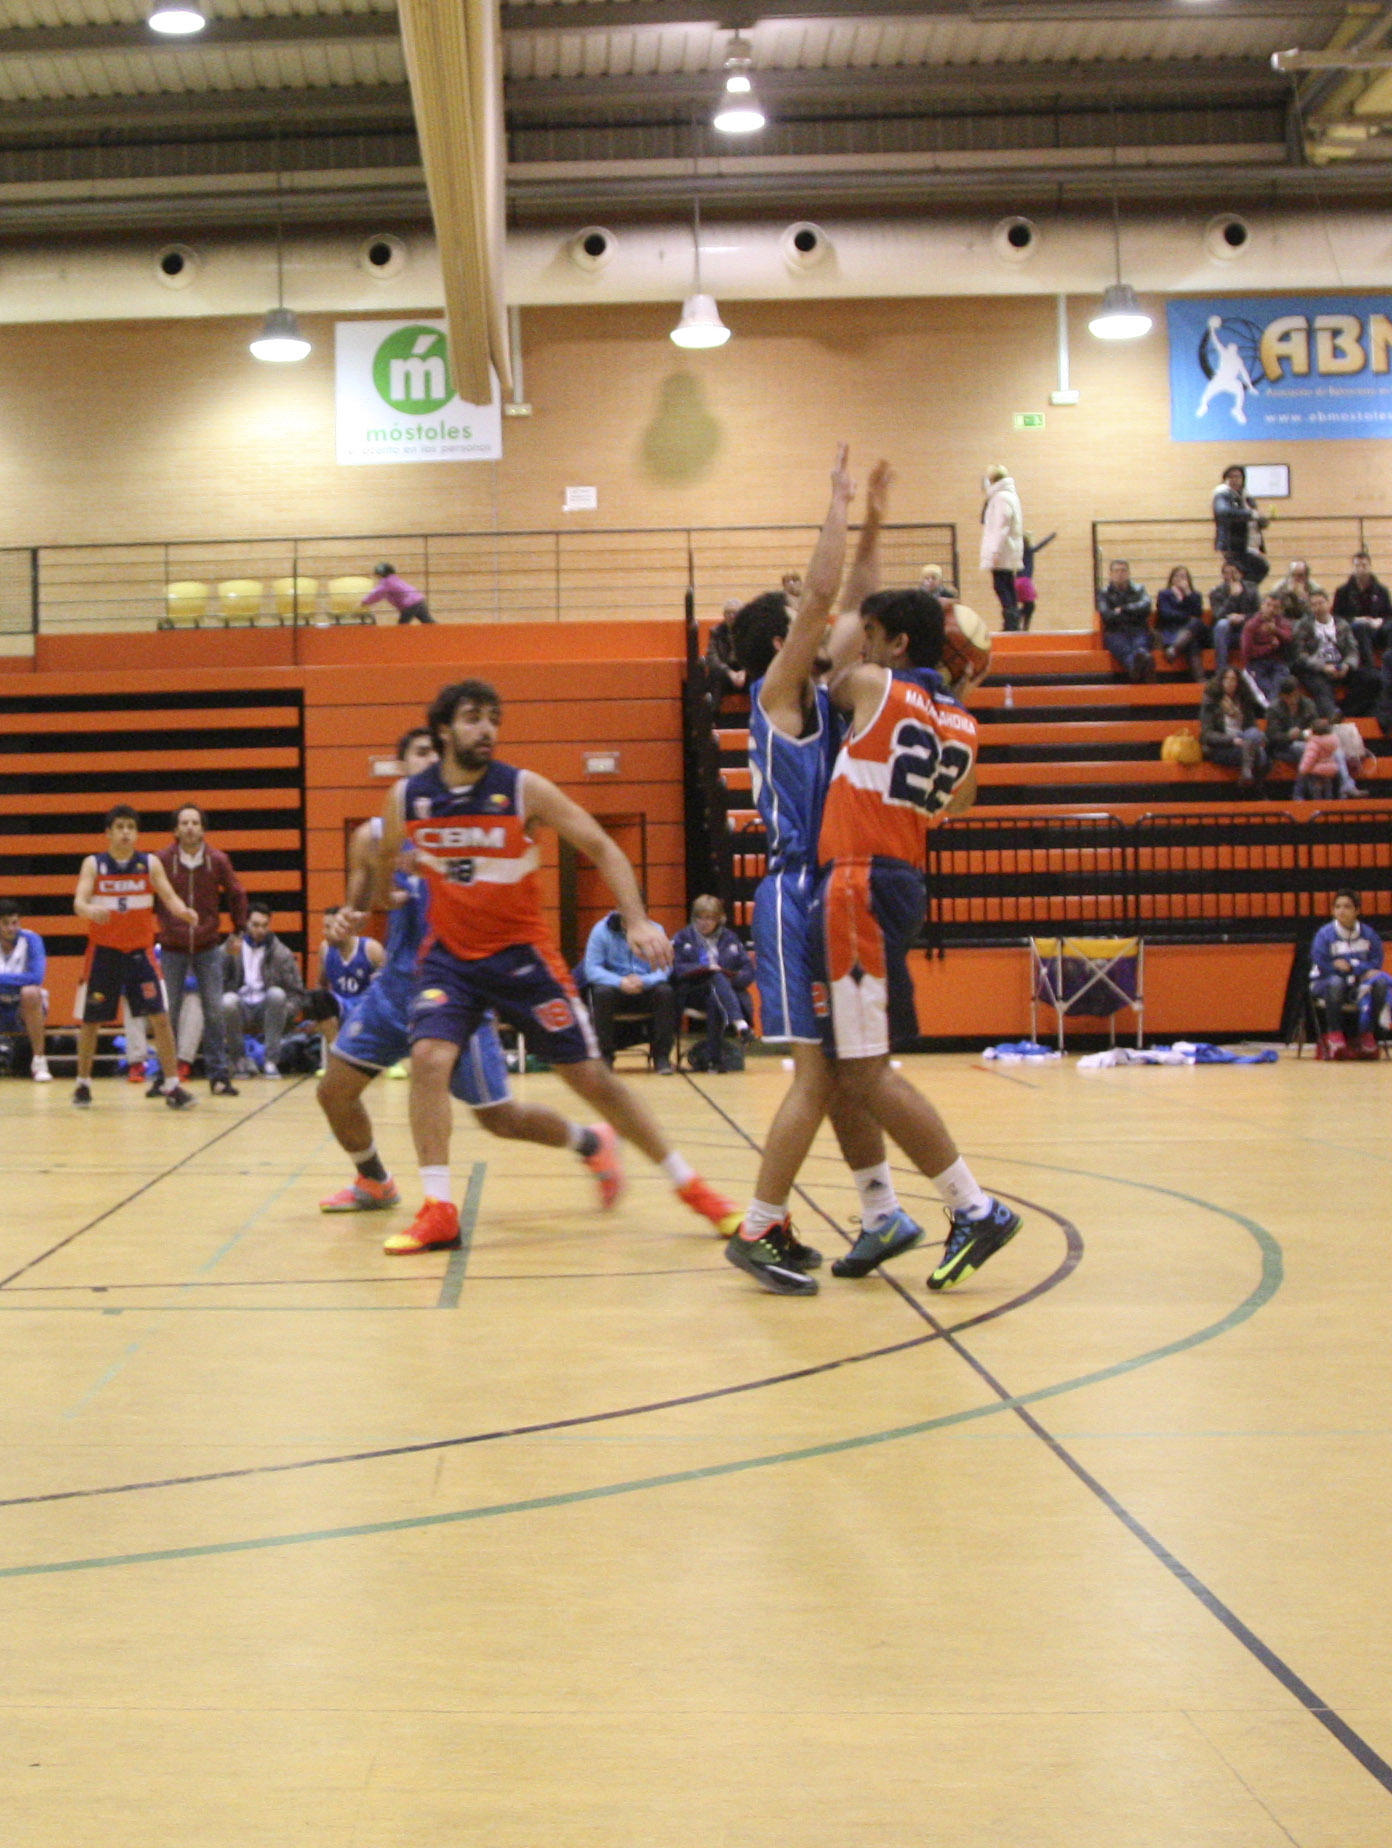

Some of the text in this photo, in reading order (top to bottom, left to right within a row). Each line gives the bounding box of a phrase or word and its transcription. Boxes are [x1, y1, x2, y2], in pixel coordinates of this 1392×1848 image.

[415, 827, 506, 848] CBM
[98, 879, 147, 893] CBM
[117, 897, 127, 912] 5
[338, 976, 359, 993] 10
